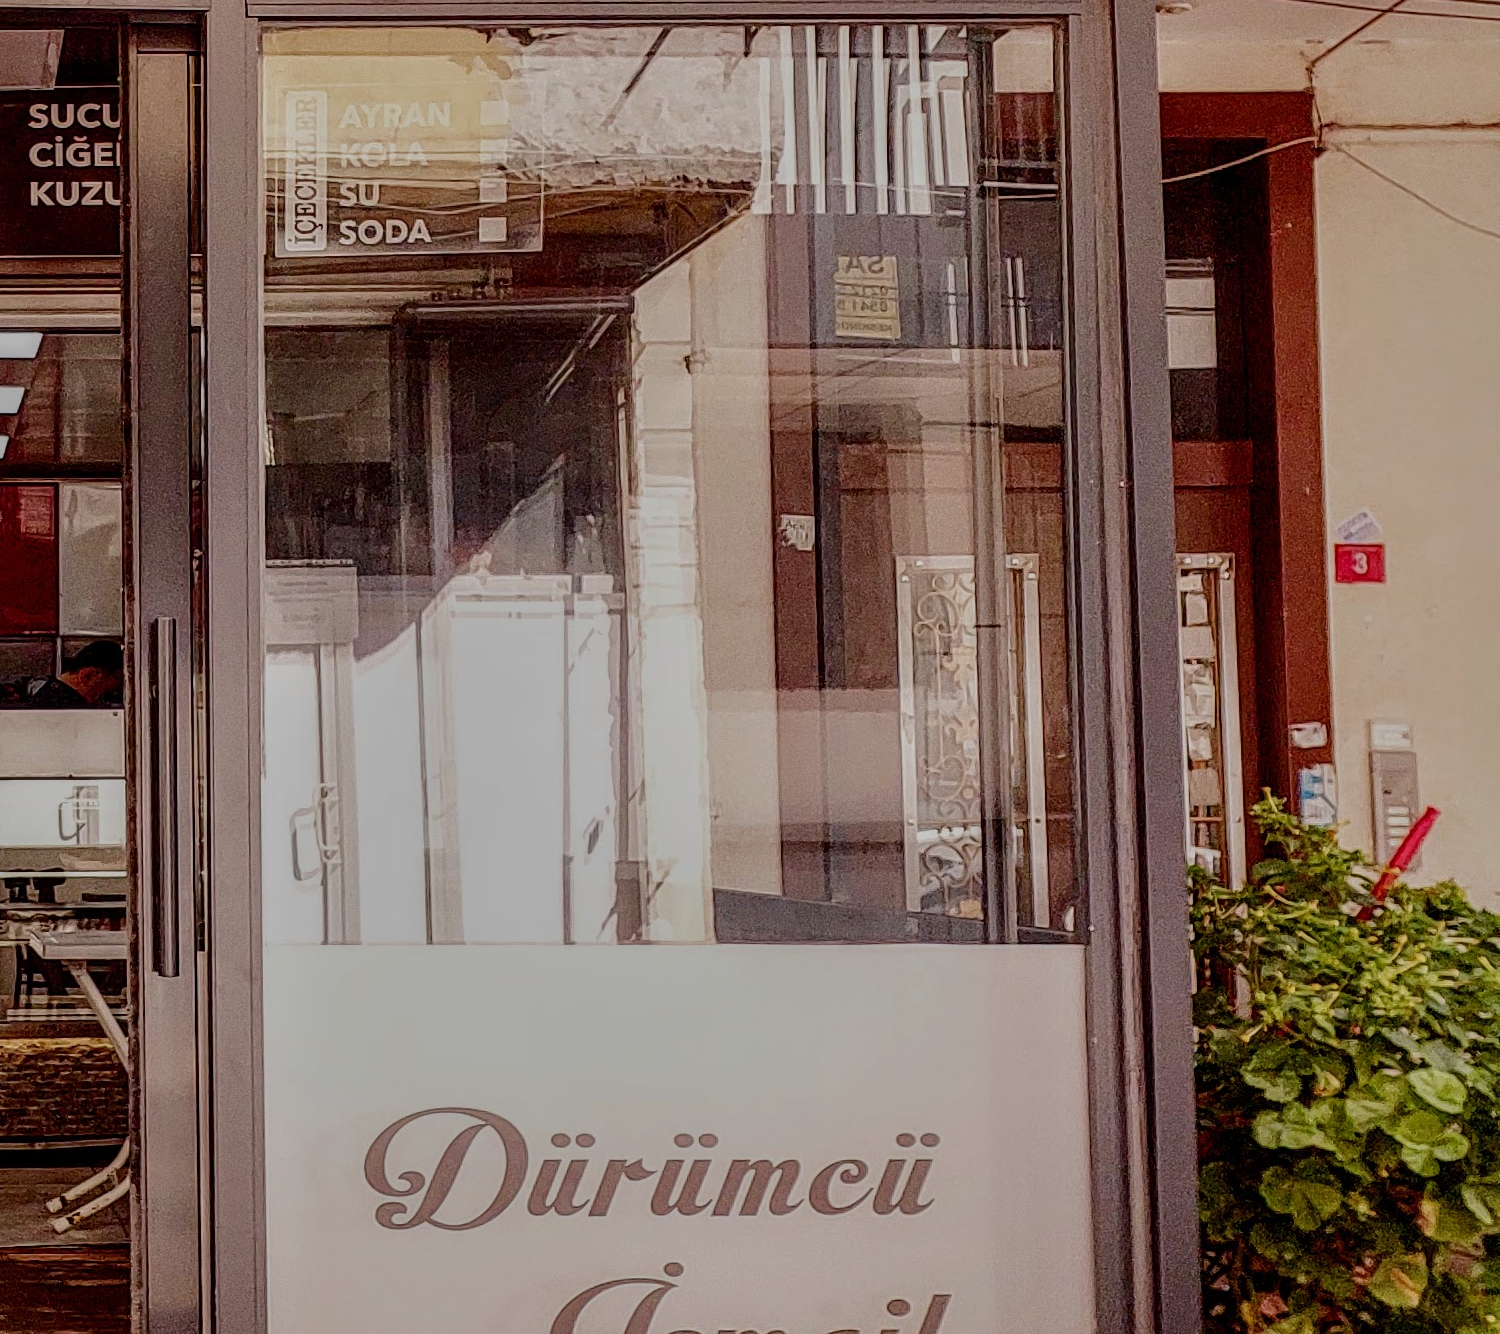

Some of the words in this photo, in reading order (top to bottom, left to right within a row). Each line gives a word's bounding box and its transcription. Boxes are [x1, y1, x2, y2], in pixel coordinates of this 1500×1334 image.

[338, 101, 451, 129] AYRAN
[339, 142, 430, 168] KOLA
[339, 182, 381, 207] SU
[338, 219, 433, 245] SODA
[363, 1106, 941, 1231] Dürümcü
